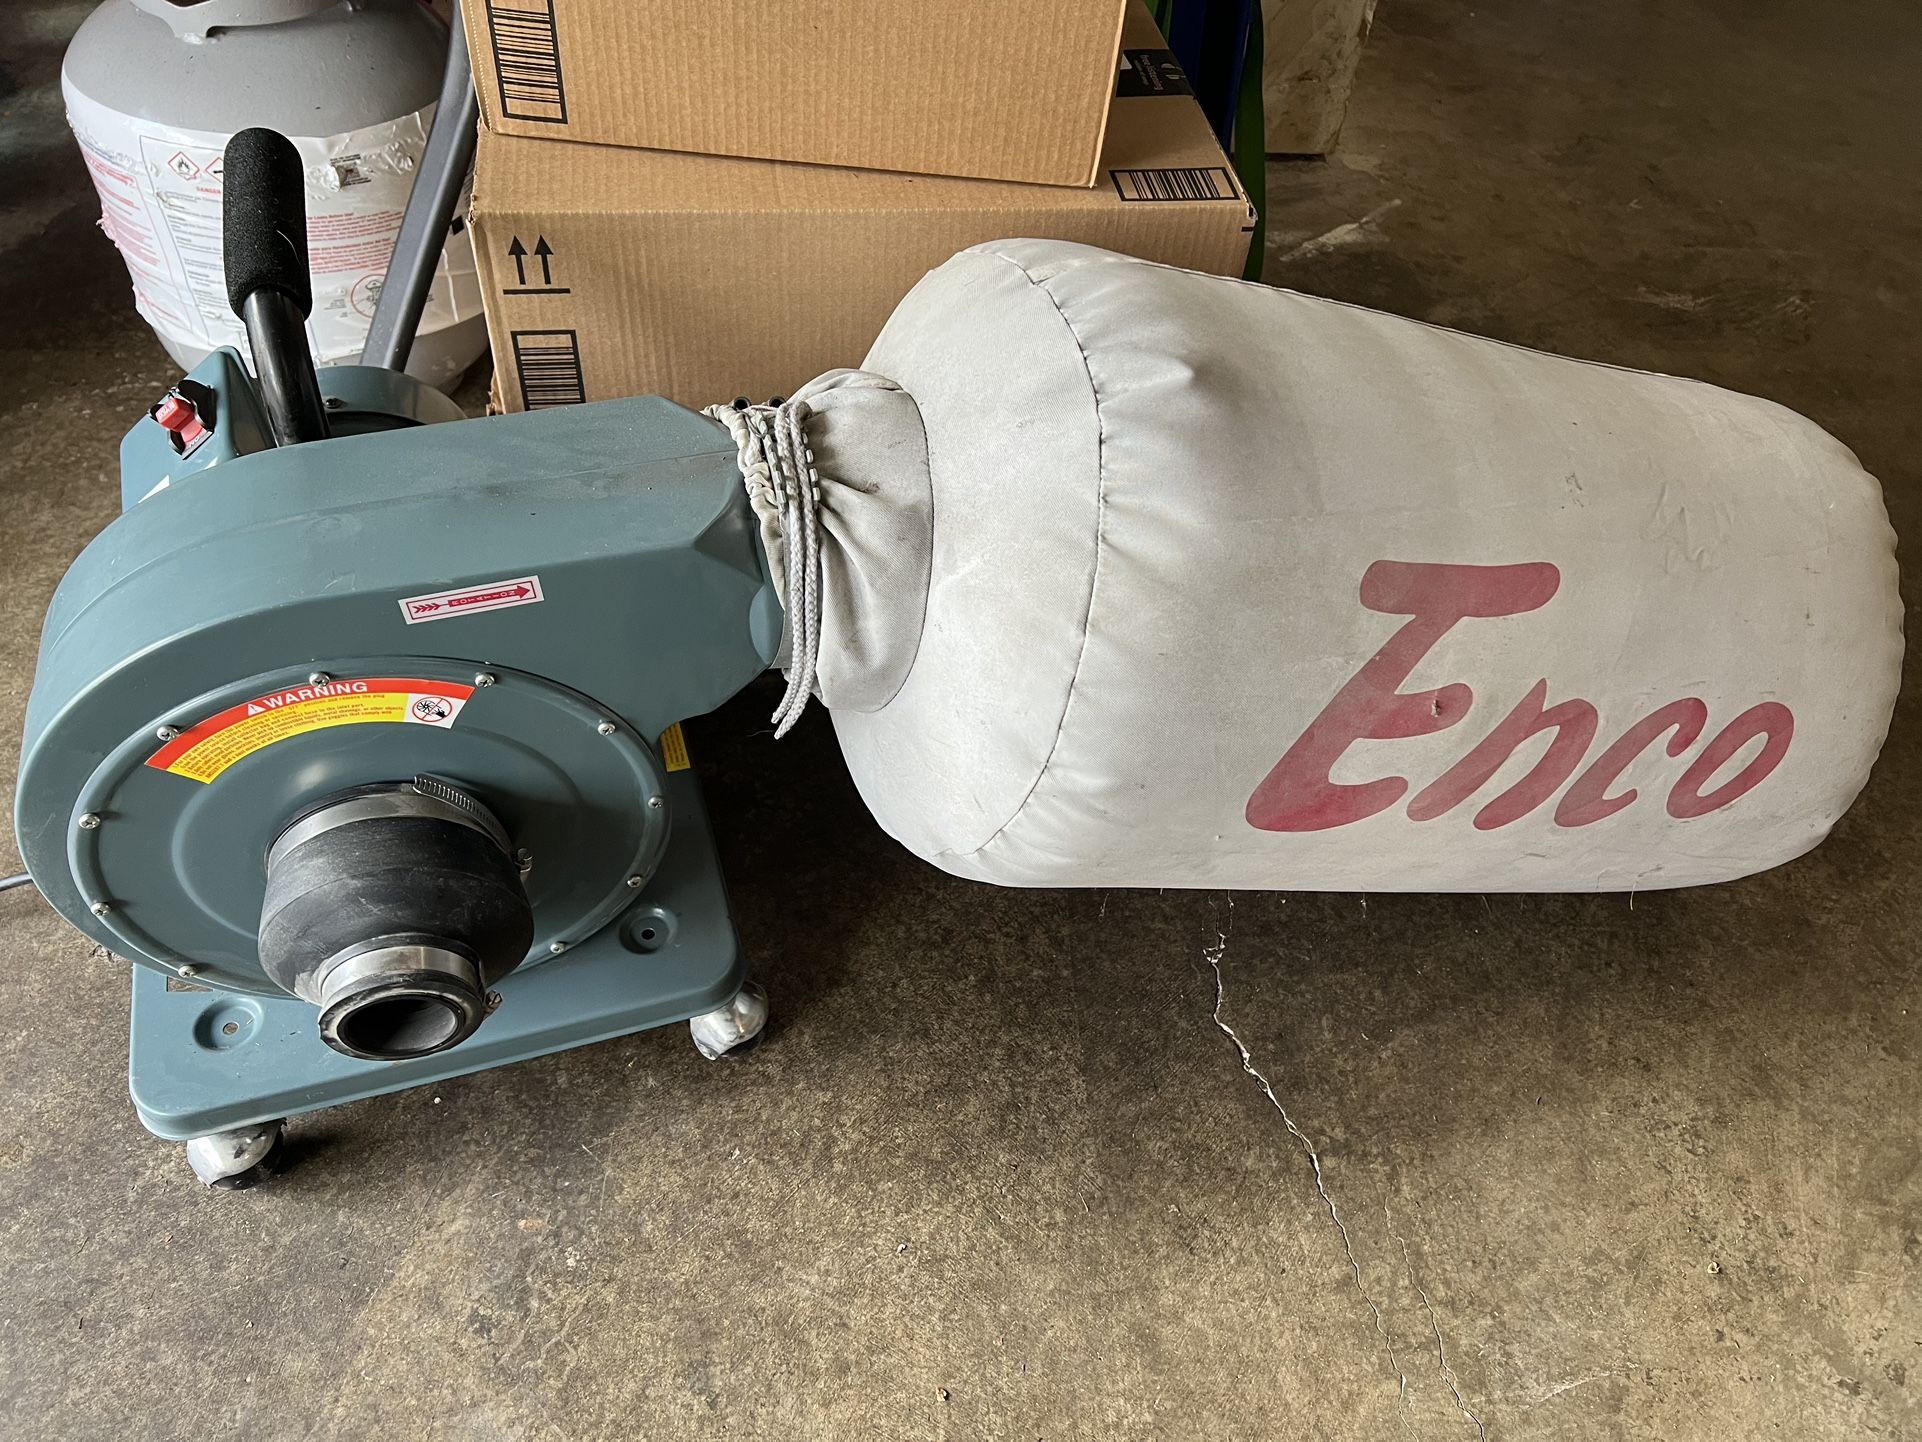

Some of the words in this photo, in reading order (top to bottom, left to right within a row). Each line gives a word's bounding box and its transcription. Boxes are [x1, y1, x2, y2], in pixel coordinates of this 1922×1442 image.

[452, 590, 515, 605] ROTATION
[263, 682, 368, 708] WARNING
[1245, 559, 1794, 832] Enco
